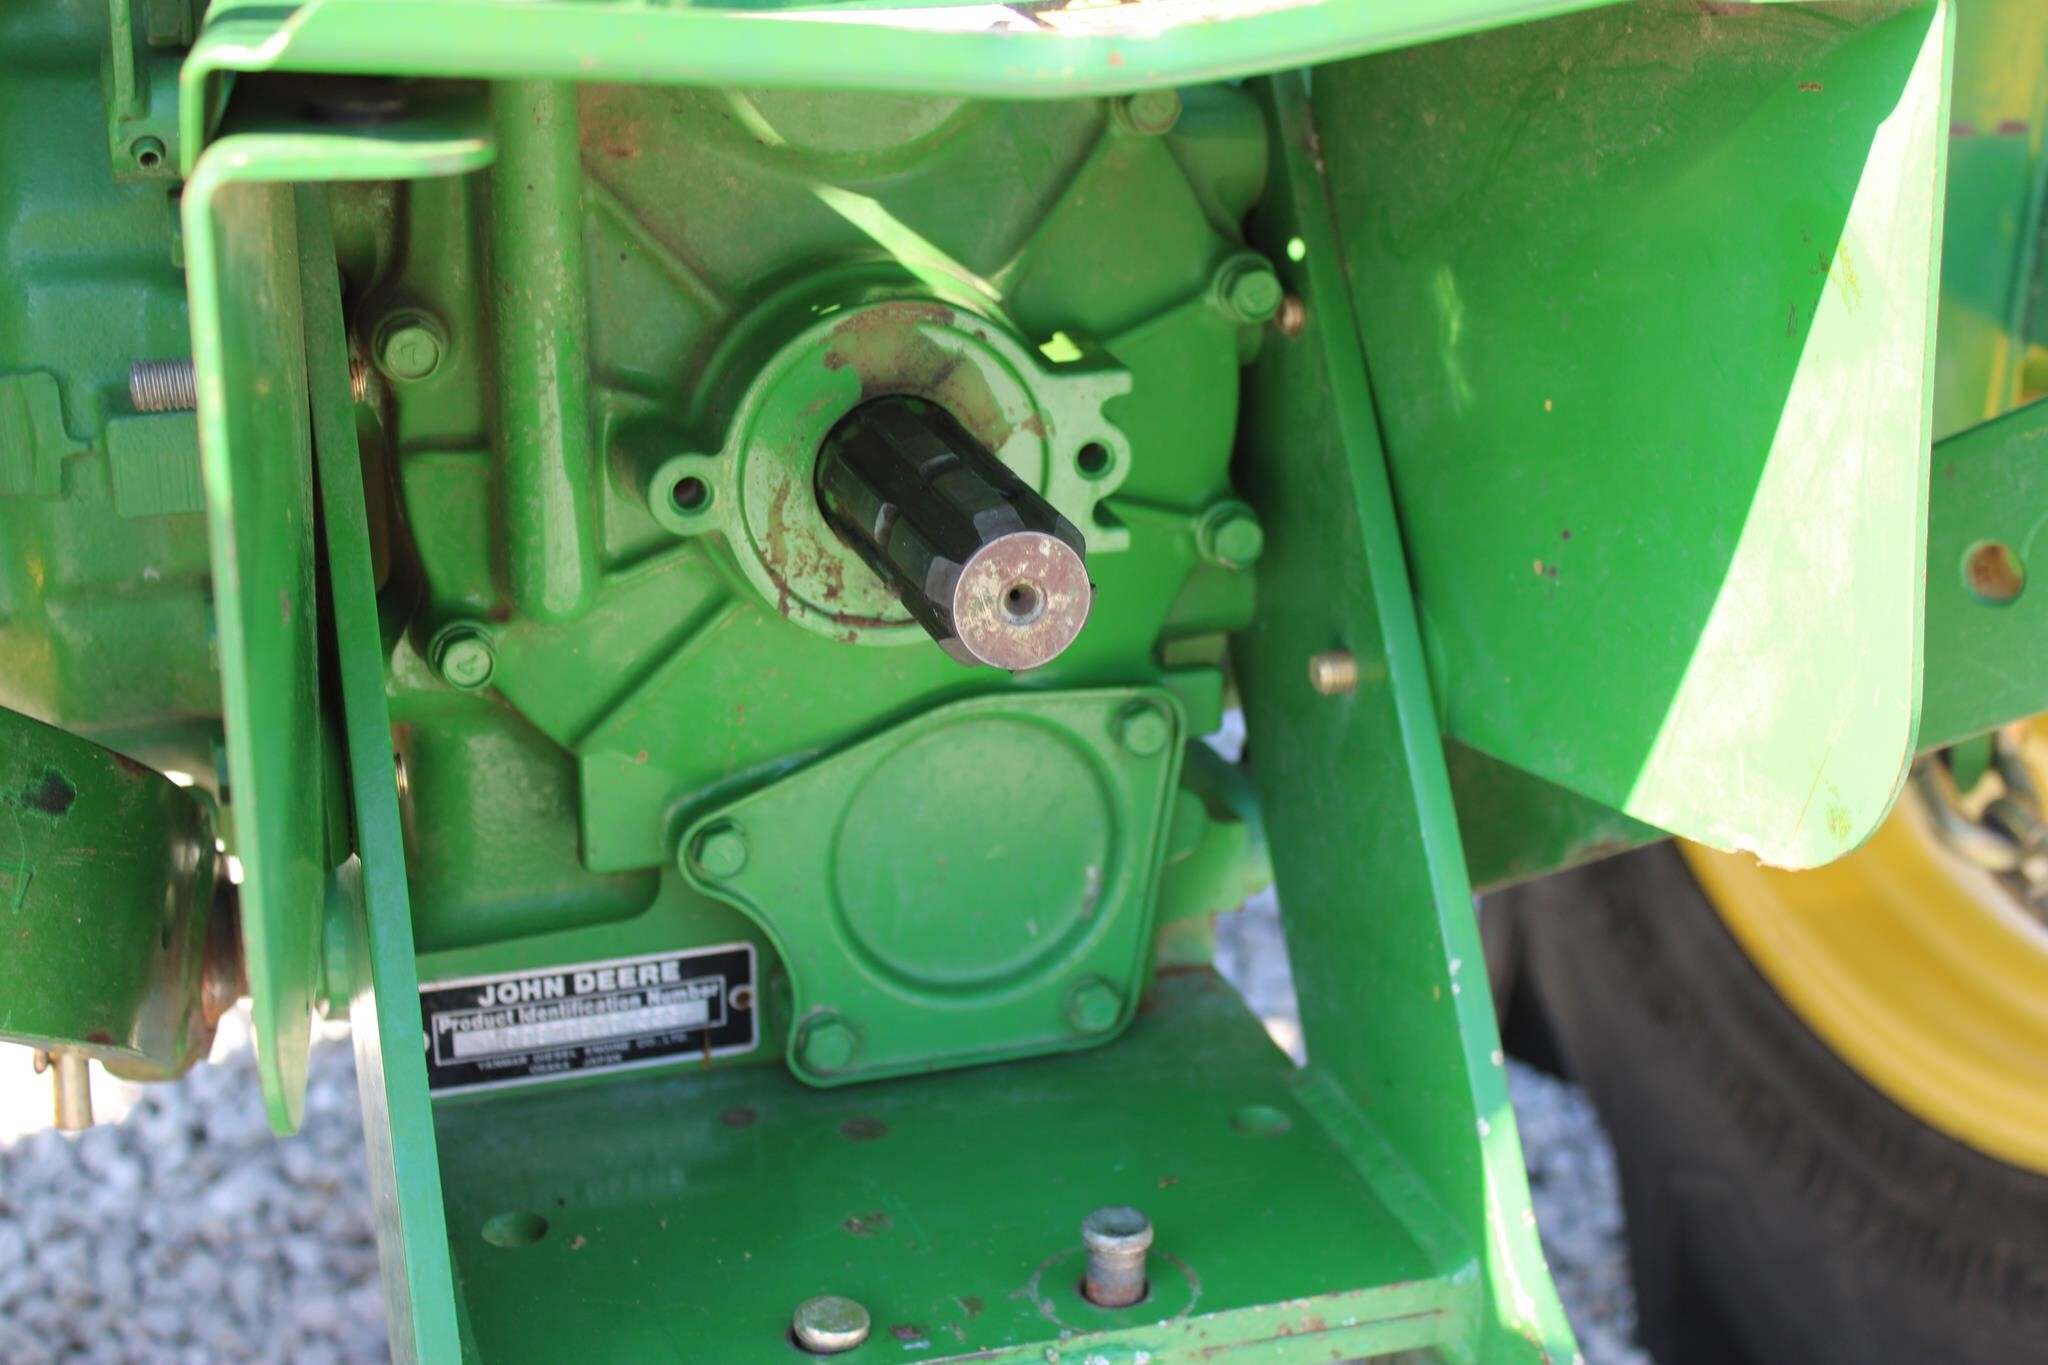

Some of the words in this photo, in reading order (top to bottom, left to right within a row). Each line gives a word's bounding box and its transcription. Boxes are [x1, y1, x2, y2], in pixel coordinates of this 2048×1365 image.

[438, 1008, 514, 1035] Product
[518, 994, 642, 1025] Identification
[646, 981, 719, 1007] Number
[478, 976, 565, 1007] JOHN
[574, 960, 681, 994] DEERE
